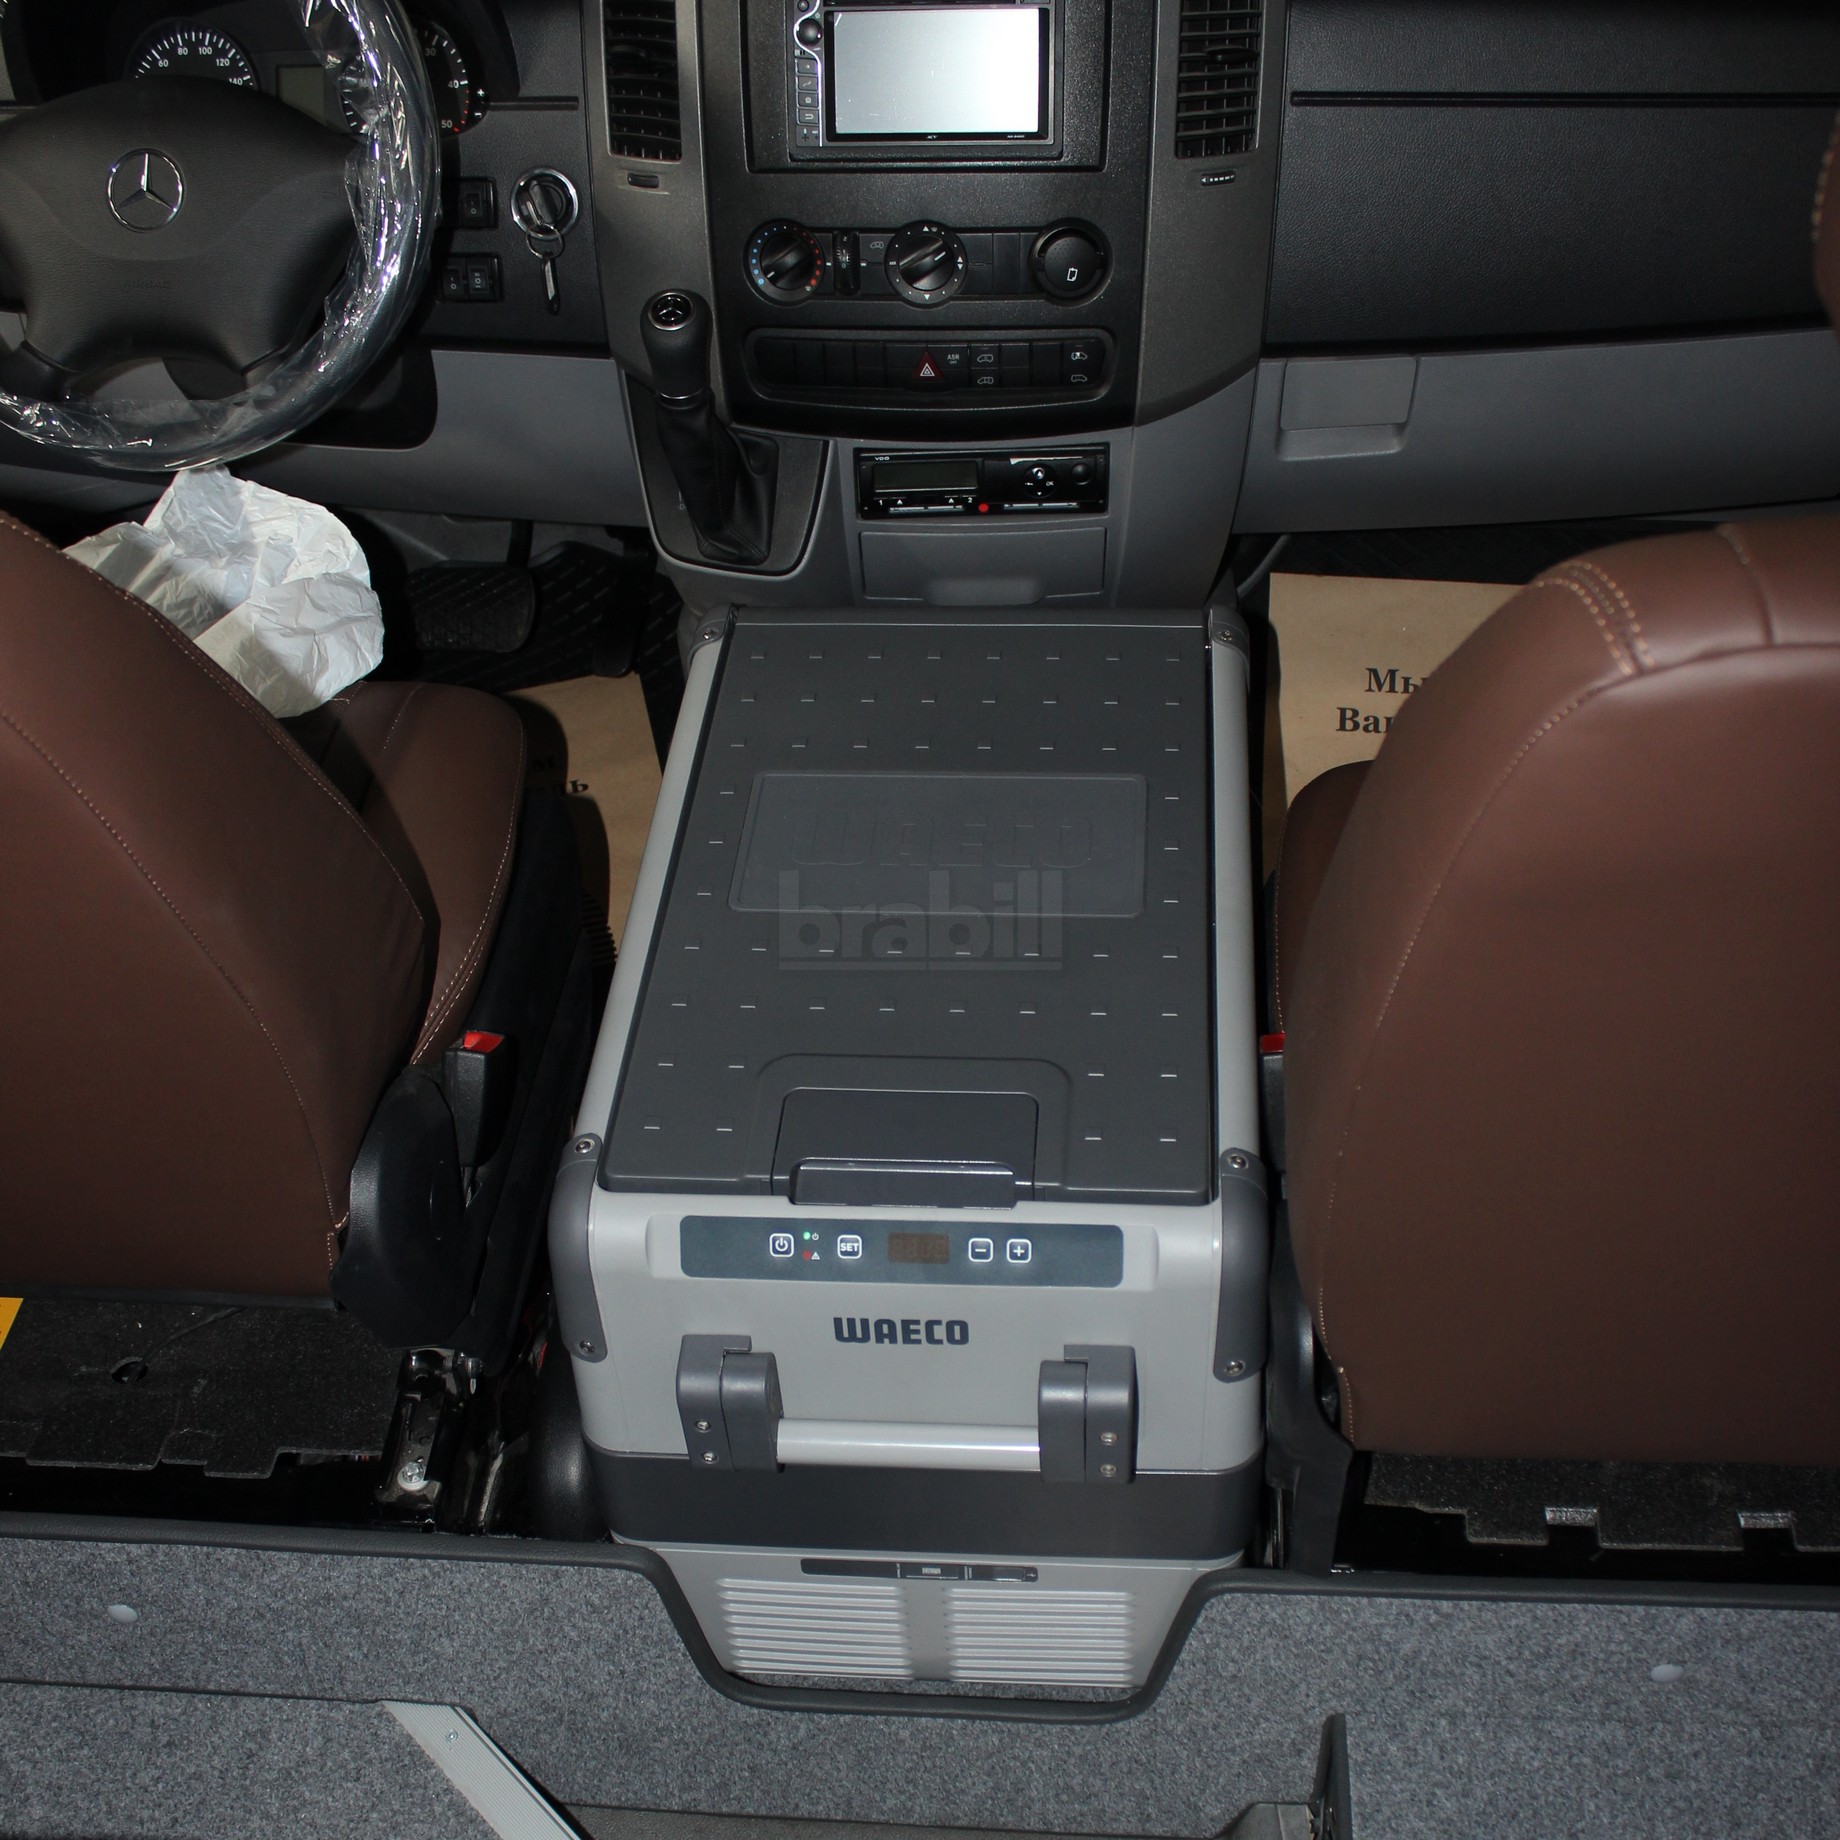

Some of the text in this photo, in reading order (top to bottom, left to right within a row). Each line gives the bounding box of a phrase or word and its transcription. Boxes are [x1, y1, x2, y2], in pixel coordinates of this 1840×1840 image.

[177, 47, 188, 56] 80
[198, 47, 213, 55] 100
[424, 49, 436, 57] 30
[158, 59, 169, 67] 60
[216, 58, 230, 67] 120
[447, 81, 460, 89] 40
[441, 120, 452, 128] 50
[946, 353, 960, 361] ASR
[840, 1242, 860, 1252] SET
[832, 1316, 970, 1346] WAECO
